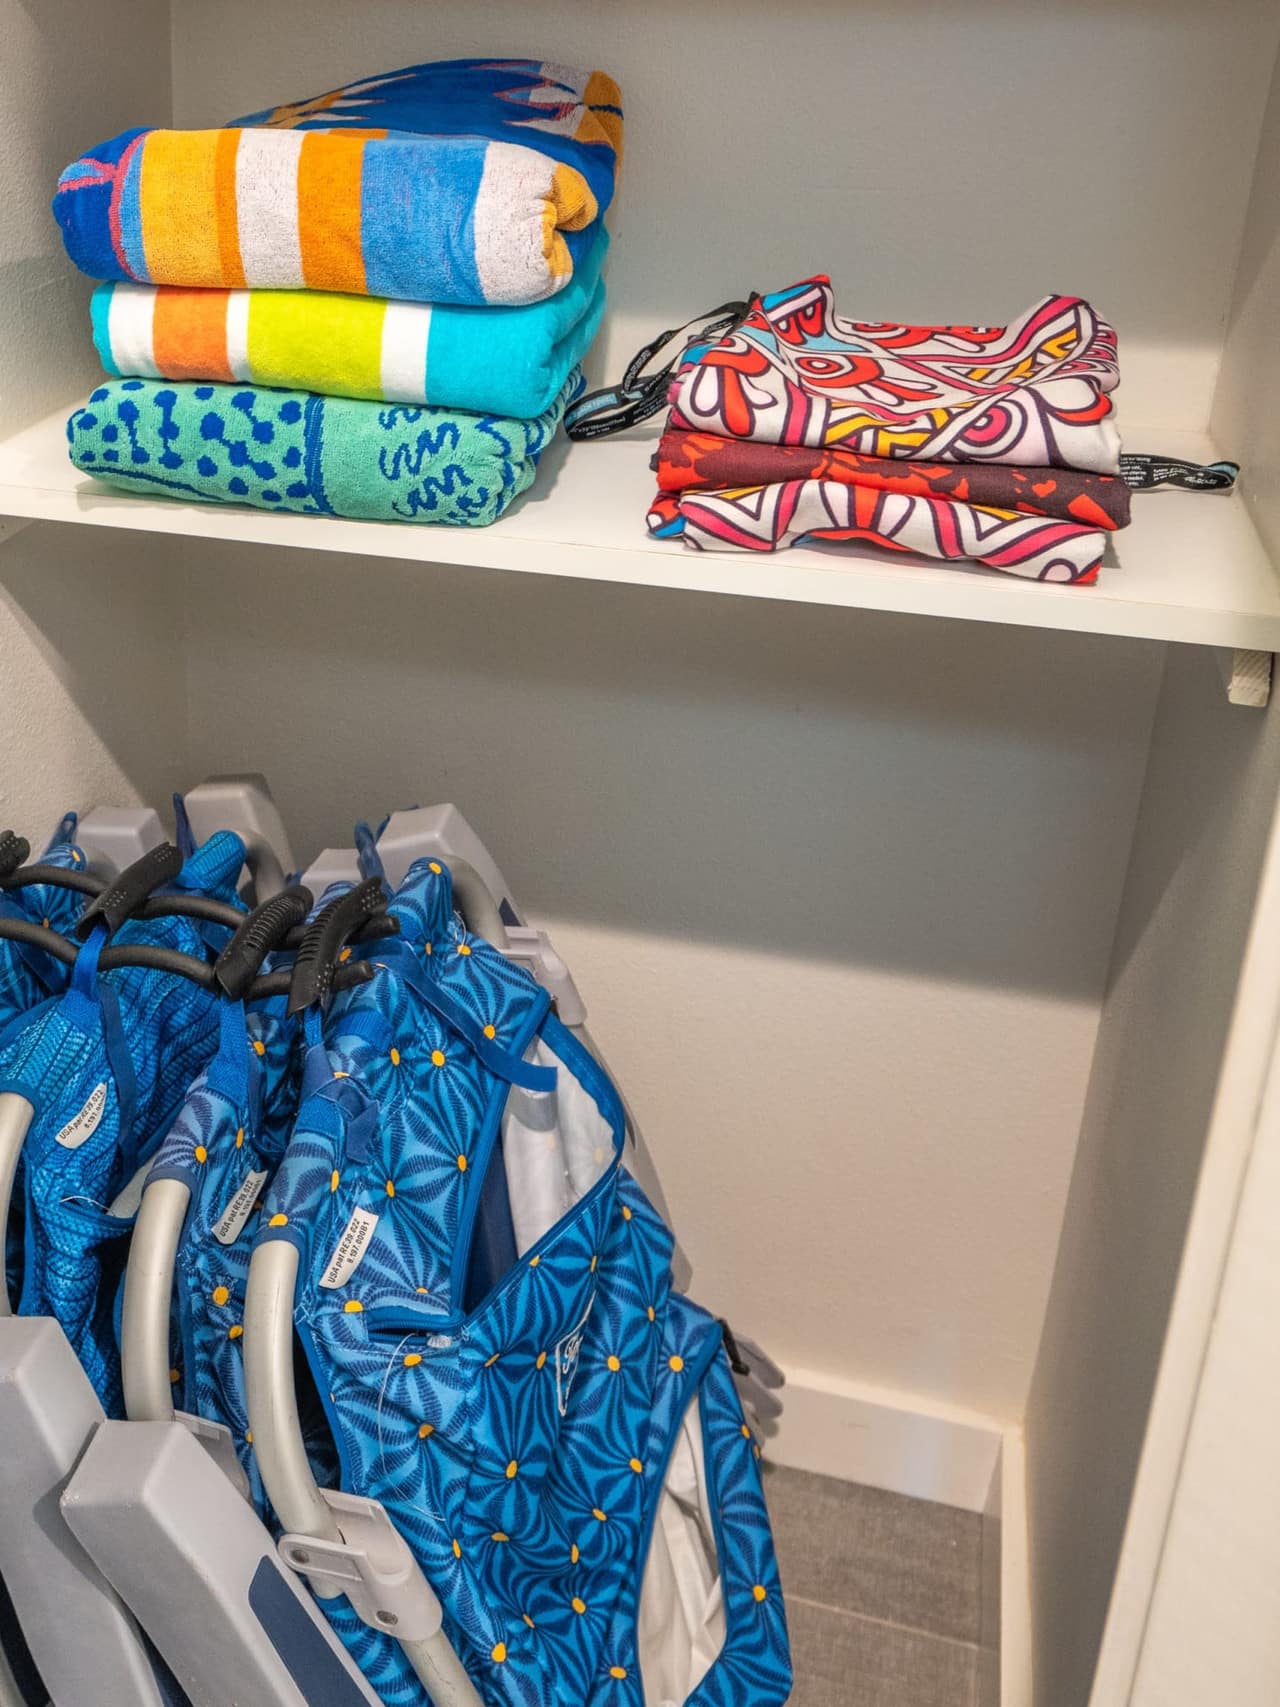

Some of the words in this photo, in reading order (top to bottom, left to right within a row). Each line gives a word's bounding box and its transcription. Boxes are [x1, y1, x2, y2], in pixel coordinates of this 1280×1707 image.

[59, 1125, 74, 1139] USA
[220, 1221, 231, 1236] USA
[328, 1267, 339, 1283] USA
[336, 1253, 344, 1268] pat
